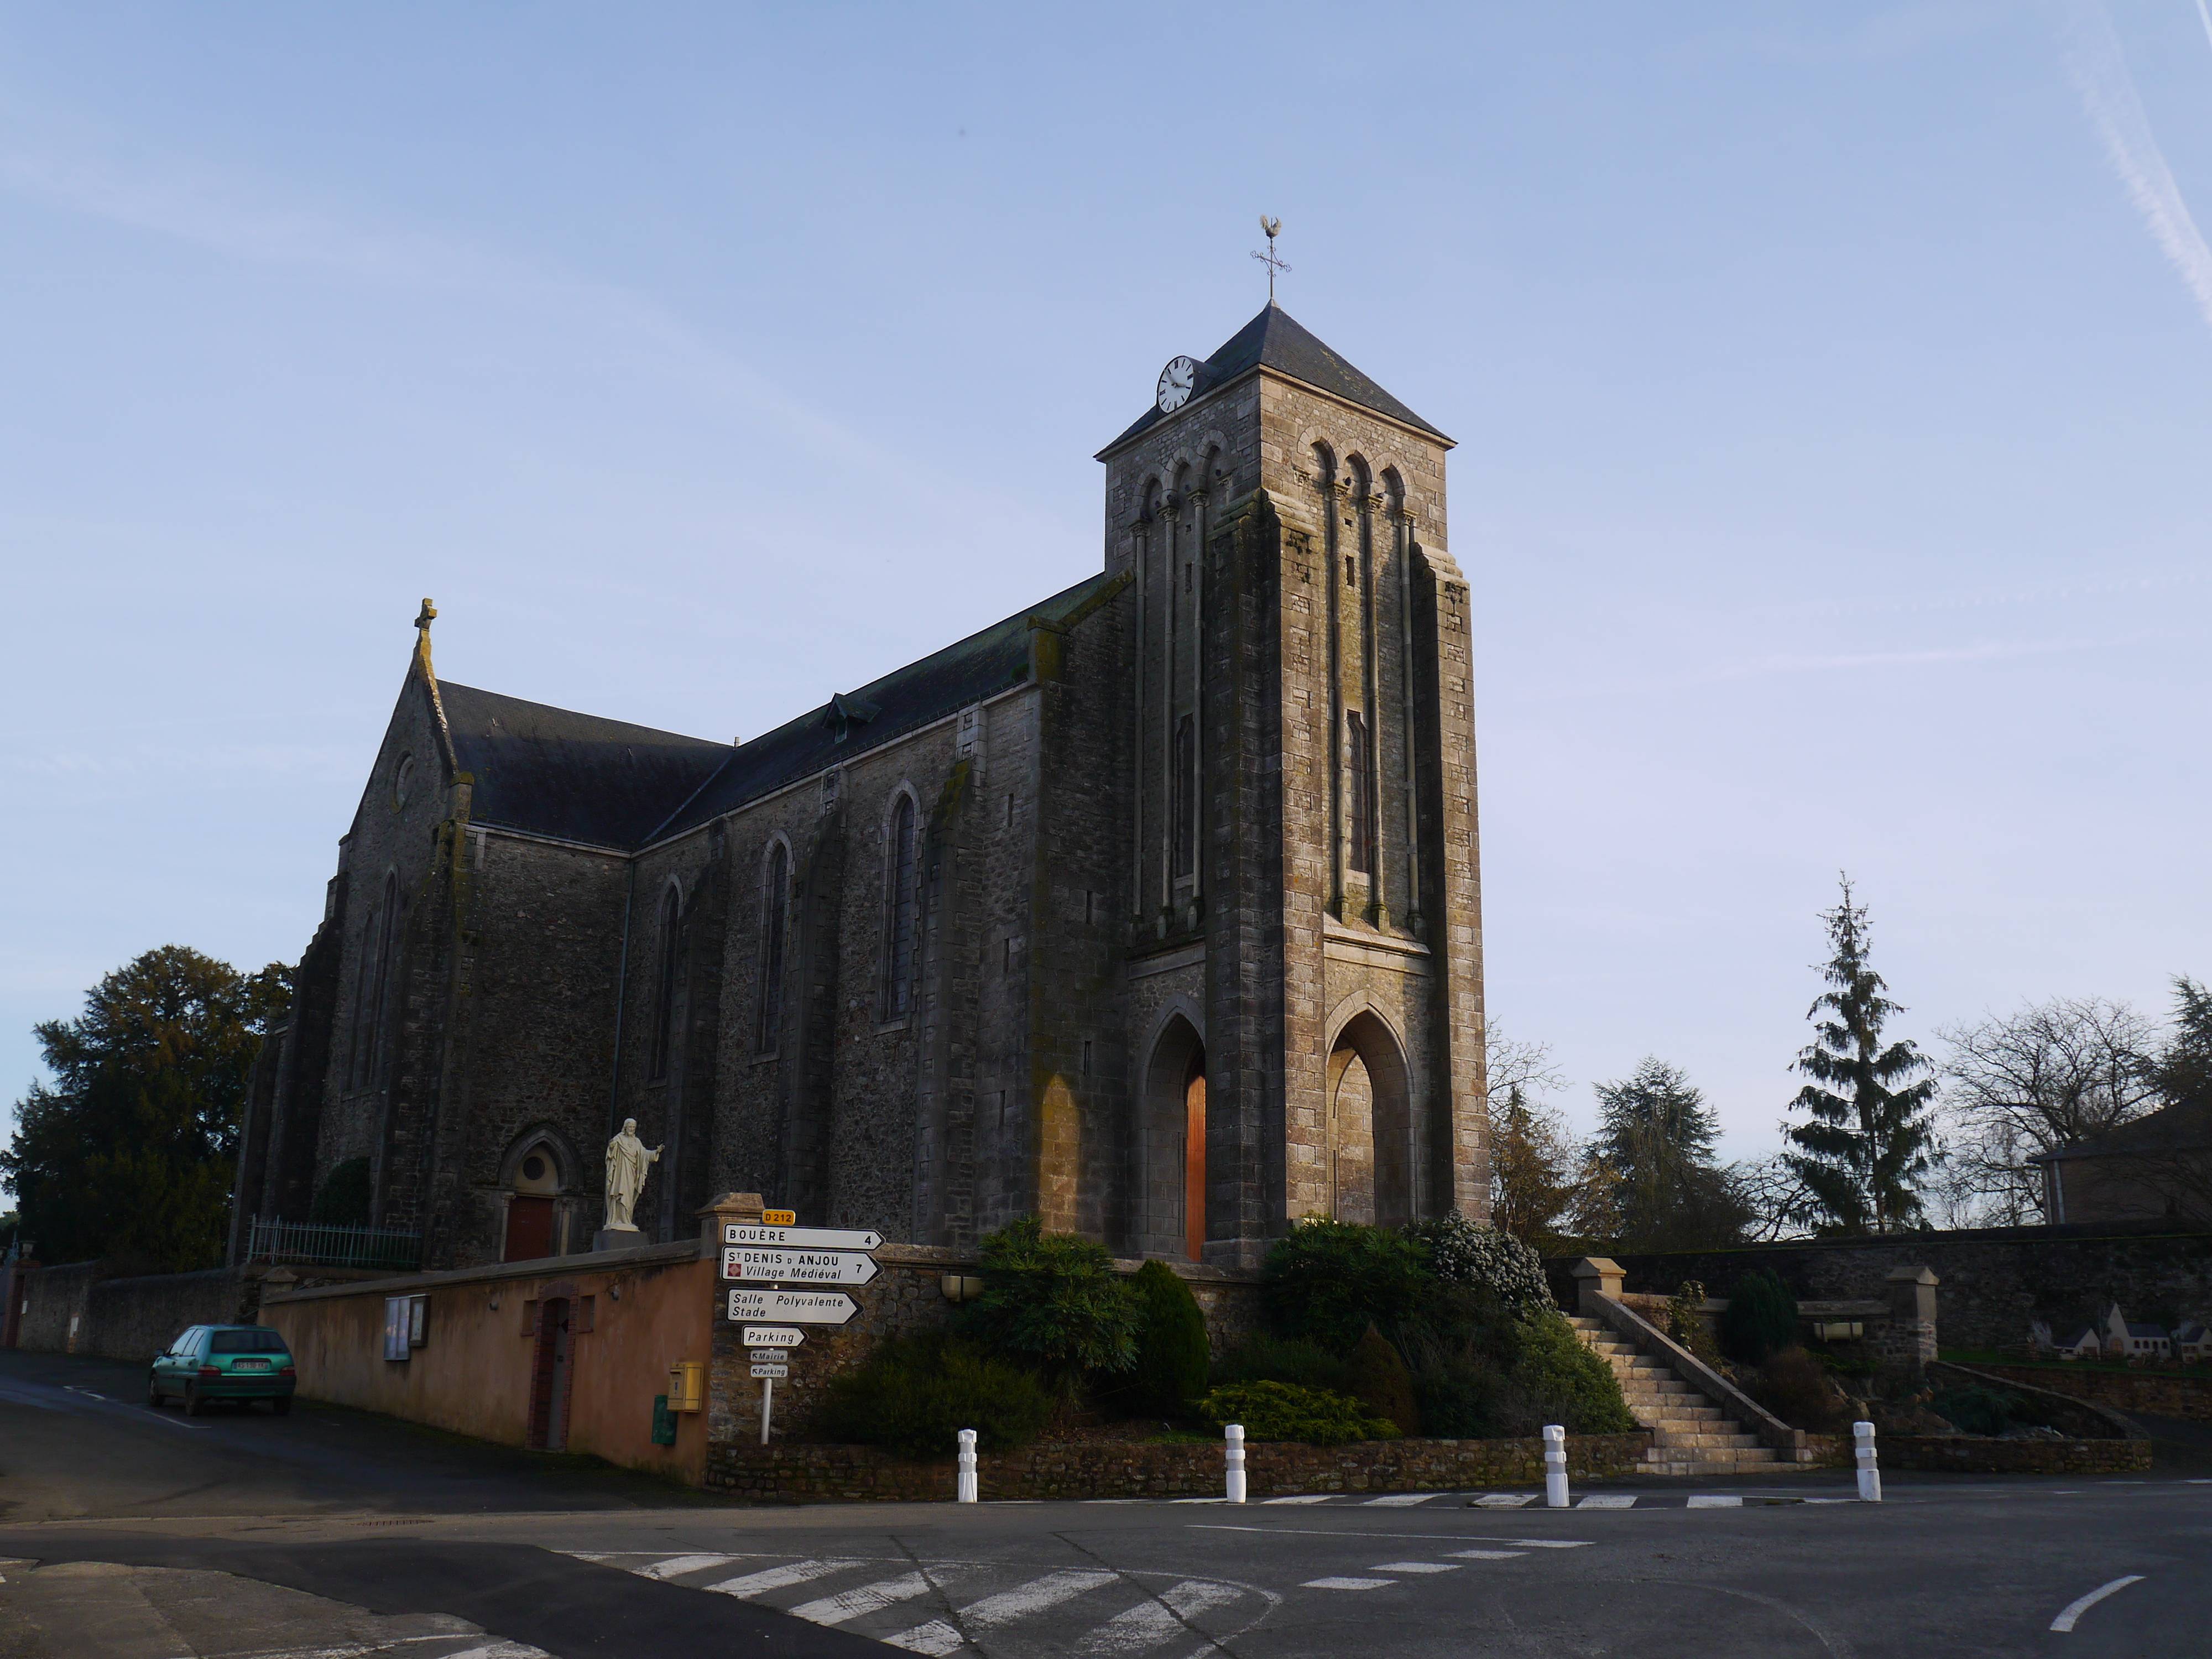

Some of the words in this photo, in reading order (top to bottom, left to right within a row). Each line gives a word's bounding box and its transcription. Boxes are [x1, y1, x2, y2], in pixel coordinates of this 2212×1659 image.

[729, 1229, 785, 1241] BOUÈRE
[865, 1236, 872, 1245] 4
[744, 1253, 782, 1264] DENIS
[799, 1255, 838, 1266] ANJOU
[747, 1266, 784, 1279] Village
[791, 1267, 841, 1279] Médiéval
[856, 1264, 862, 1274] 7
[734, 1294, 763, 1305] Salle
[776, 1295, 843, 1307] Polyvalente
[733, 1307, 765, 1317] Stade
[748, 1332, 794, 1345] Parking
